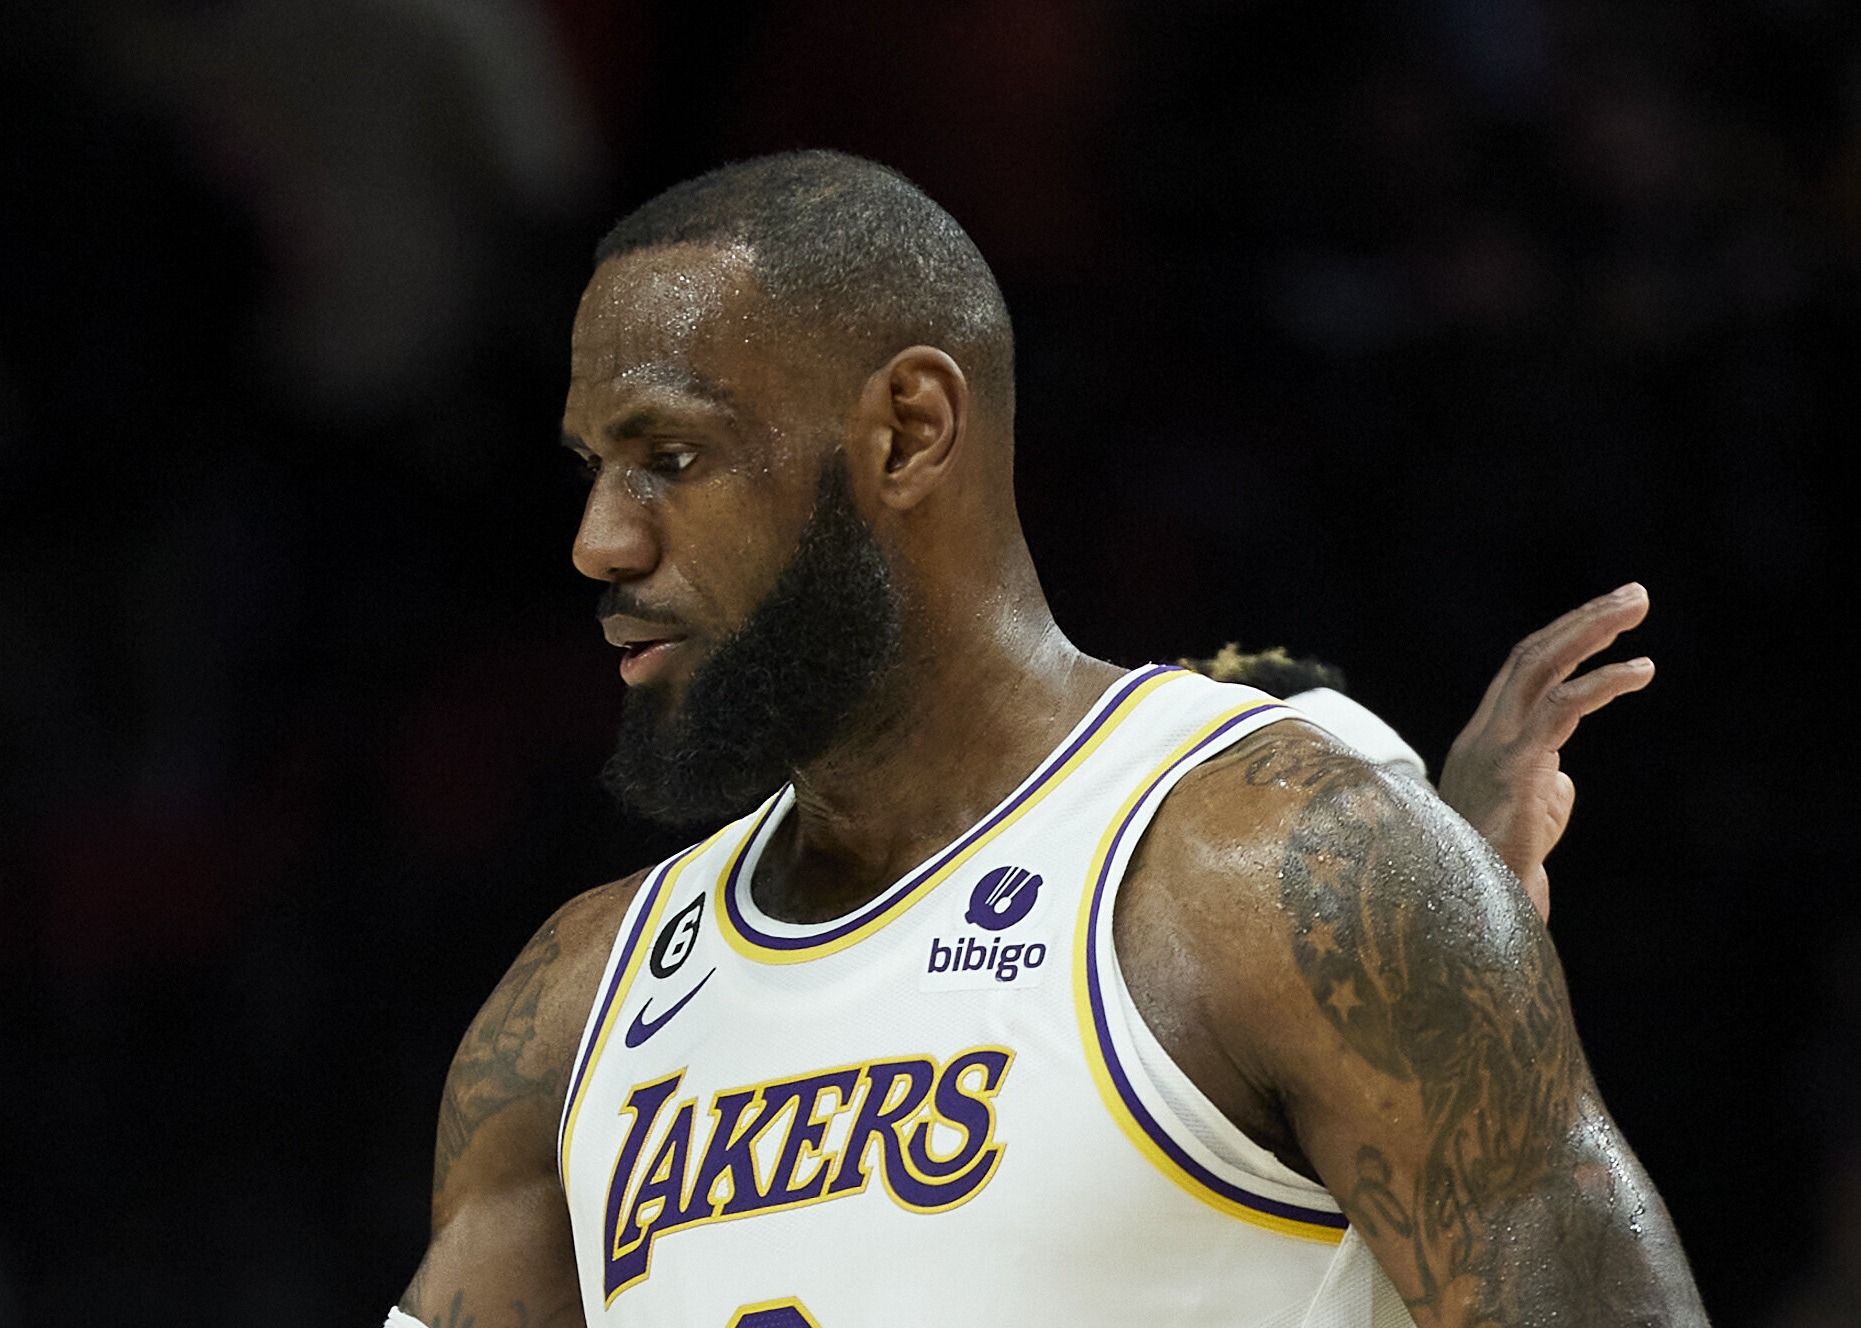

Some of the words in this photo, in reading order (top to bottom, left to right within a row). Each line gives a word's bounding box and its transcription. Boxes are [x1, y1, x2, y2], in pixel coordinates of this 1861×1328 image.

[659, 903, 702, 971] 6
[928, 938, 1047, 982] bibigo
[604, 1044, 1017, 1312] LAKERS
